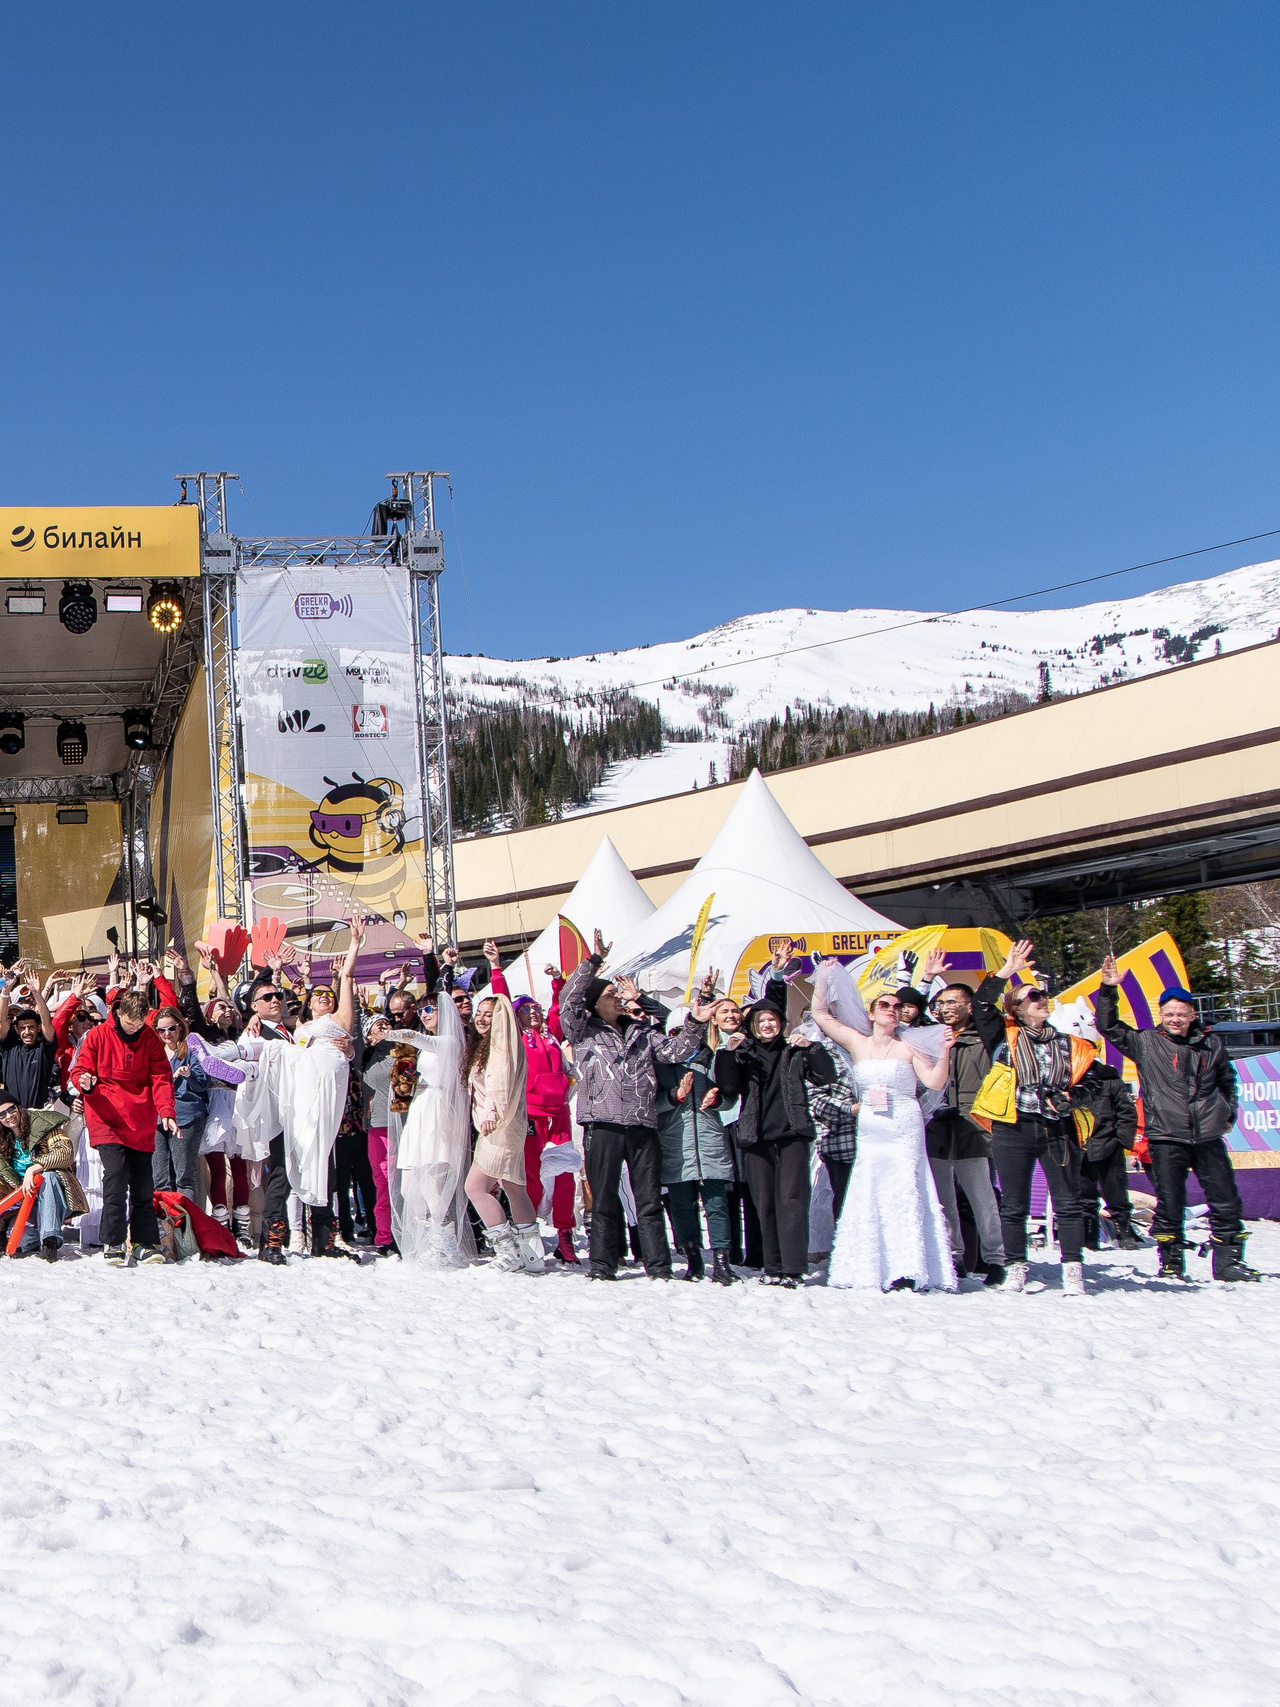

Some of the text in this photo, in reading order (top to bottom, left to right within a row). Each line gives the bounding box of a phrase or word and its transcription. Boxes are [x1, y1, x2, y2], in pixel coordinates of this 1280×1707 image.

[43, 525, 142, 549] билайн
[300, 597, 328, 606] GRELKA
[301, 607, 319, 616] FEST
[267, 664, 328, 679] drivee
[346, 667, 389, 676] MOUNTAIN
[832, 933, 881, 951] GRELK
